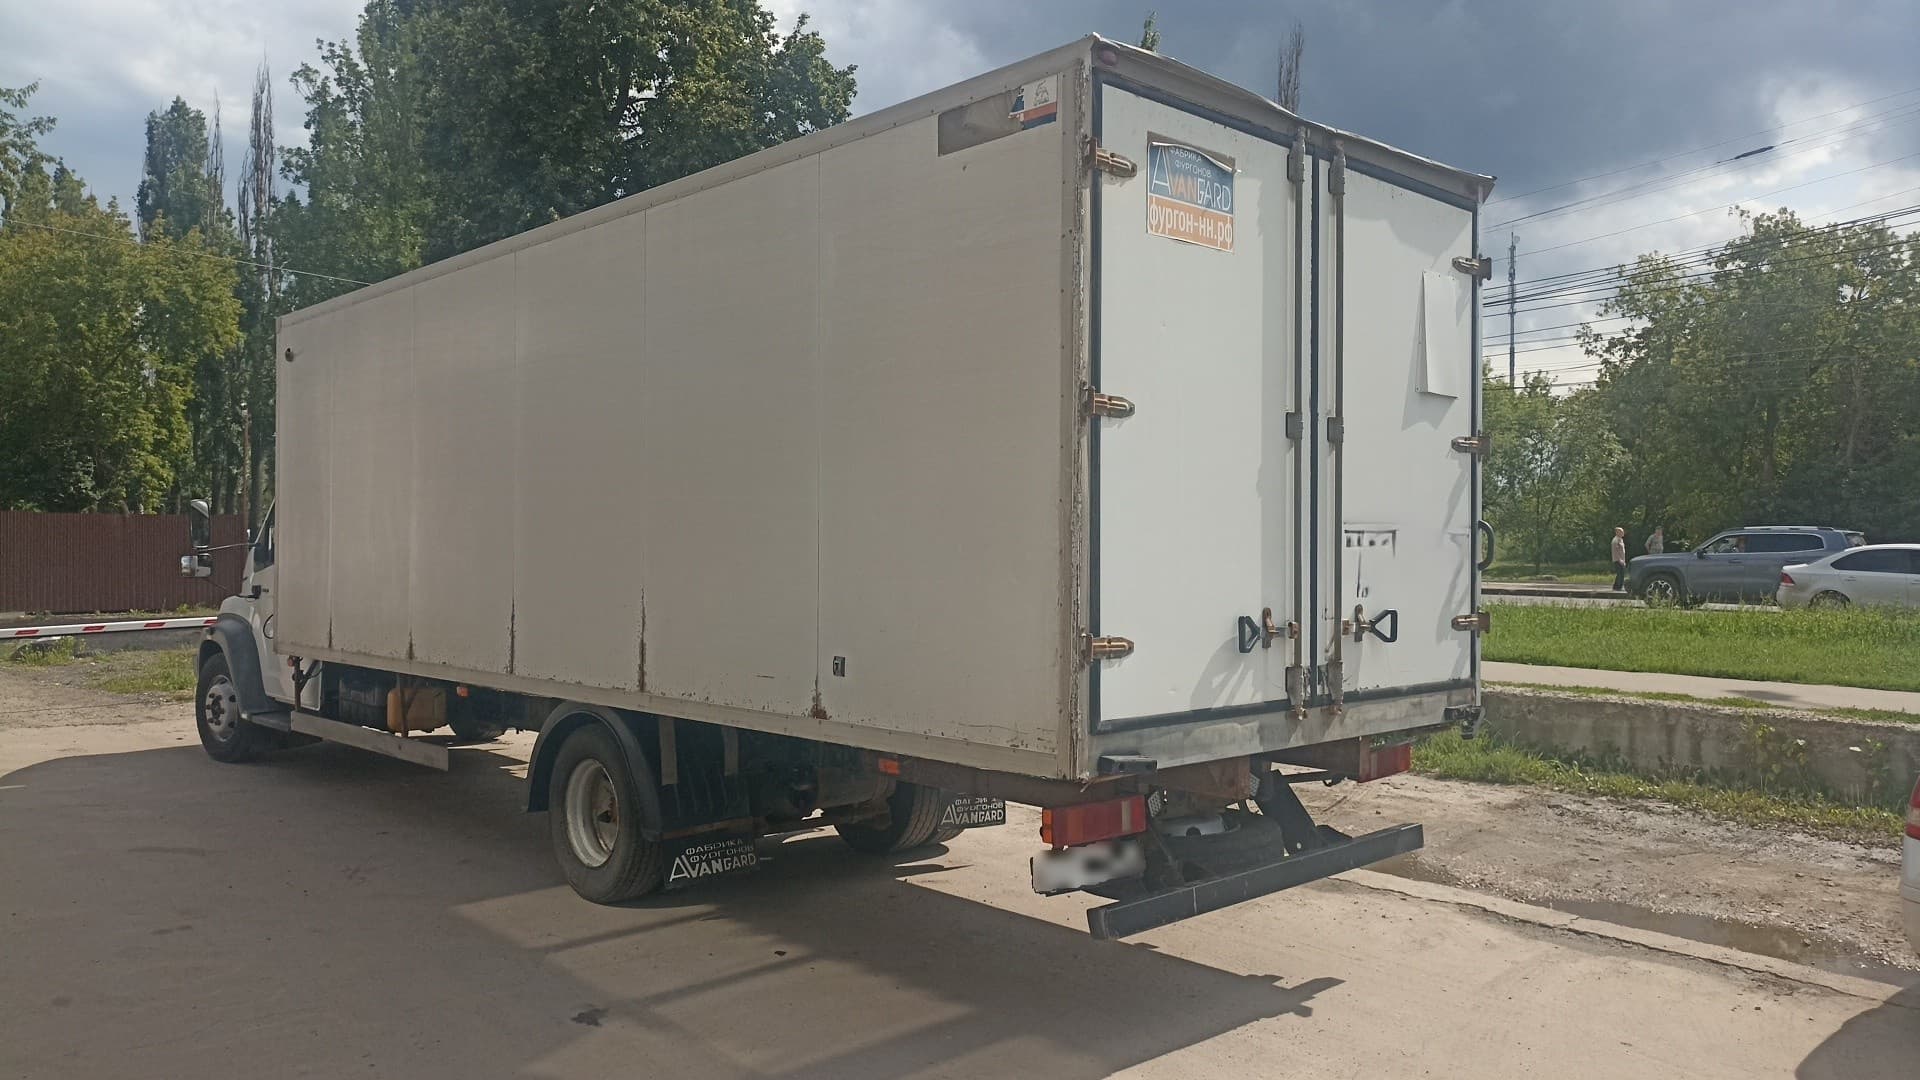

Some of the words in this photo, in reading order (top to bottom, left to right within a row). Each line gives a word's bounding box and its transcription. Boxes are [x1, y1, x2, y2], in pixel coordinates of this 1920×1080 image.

[1169, 147, 1202, 162] ФАБРИКА
[1174, 159, 1212, 178] ФУРГОНОВ
[1149, 196, 1233, 250] фургон-нн.рф
[941, 804, 1004, 825] AVANGARD
[669, 853, 756, 882] AVANGARD
